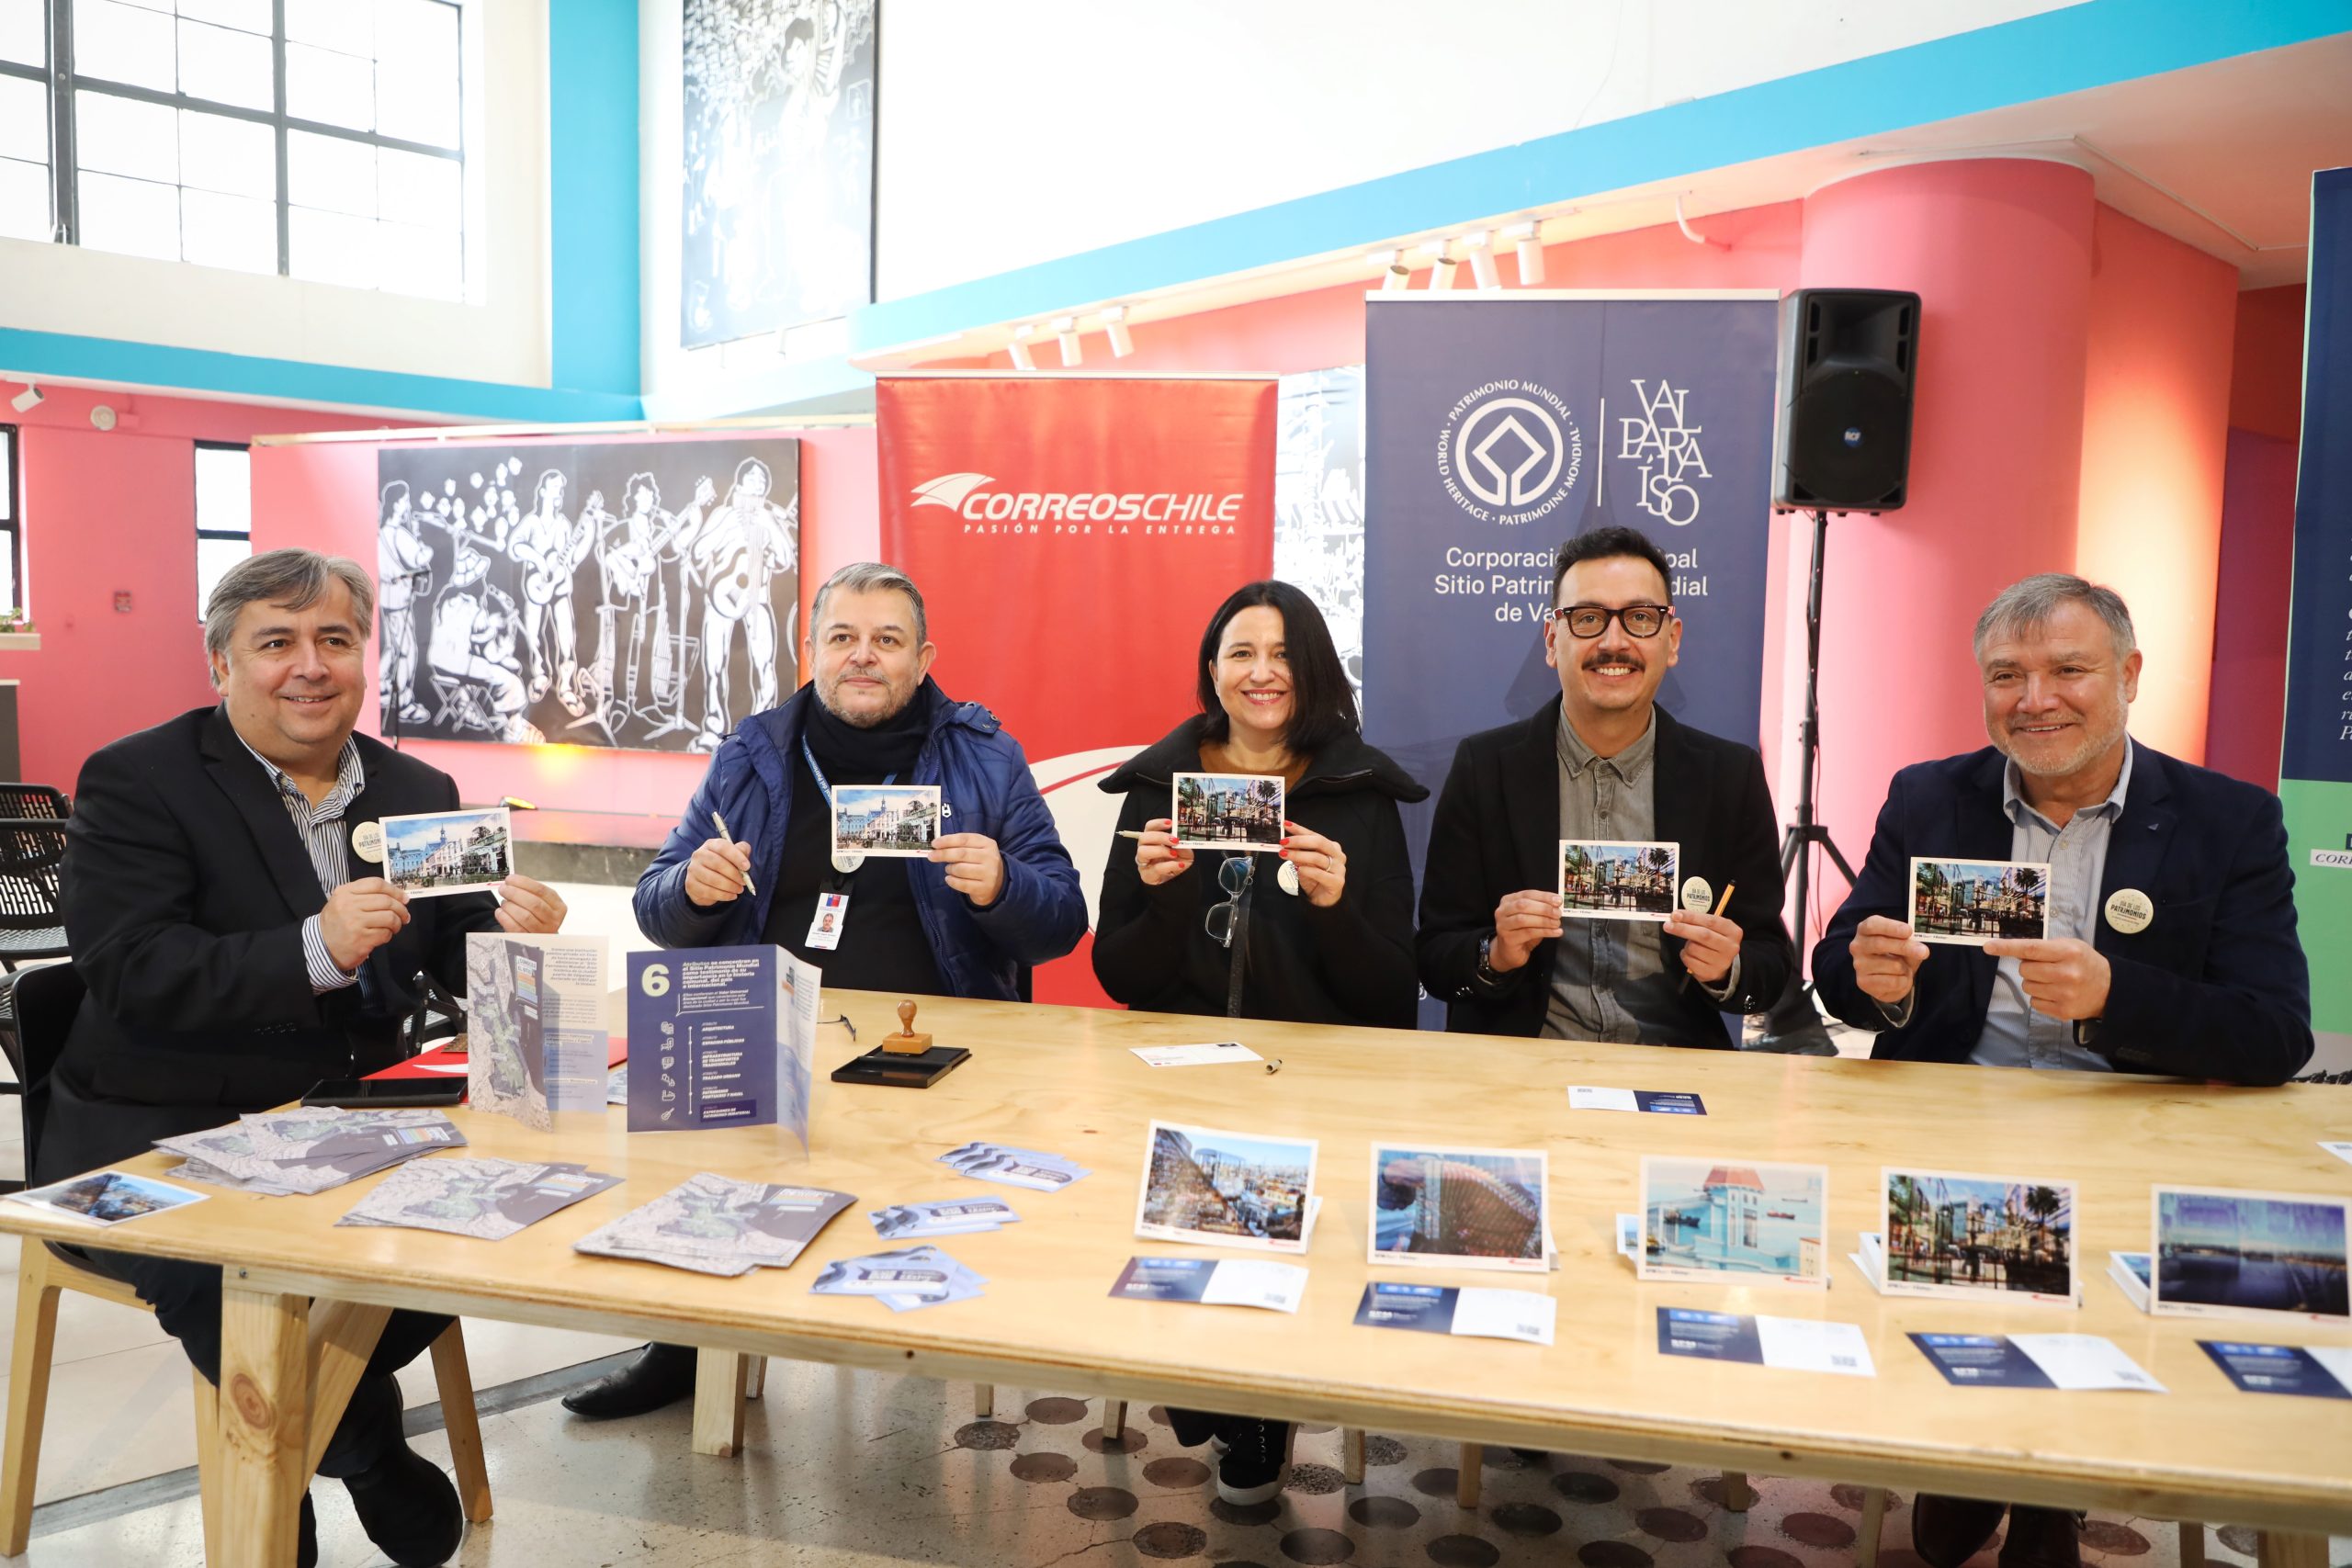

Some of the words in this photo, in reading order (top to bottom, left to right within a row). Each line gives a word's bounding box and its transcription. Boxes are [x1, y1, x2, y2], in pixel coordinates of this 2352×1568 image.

[1448, 379, 1519, 421] PATRIMONIO
[1521, 380, 1571, 421] MUNDIAL
[1437, 429, 1452, 476] WORLD
[1499, 488, 1568, 525] PATRIMOINE
[1564, 427, 1582, 489] MONDIAL
[1443, 477, 1489, 522] HERITAGE
[964, 523, 1039, 534] PASIÓN
[1056, 525, 1091, 535] POR
[1108, 525, 1129, 535] LA
[1146, 525, 1236, 535] ENTREGA
[1446, 547, 1560, 570] Corporaci
[1434, 574, 1486, 595] Sitio
[1491, 575, 1554, 595] Patri
[1671, 575, 1708, 596] dial
[1494, 602, 1523, 623] de
[2110, 905, 2147, 919] PATRIMONIOS
[641, 964, 670, 997] 6
